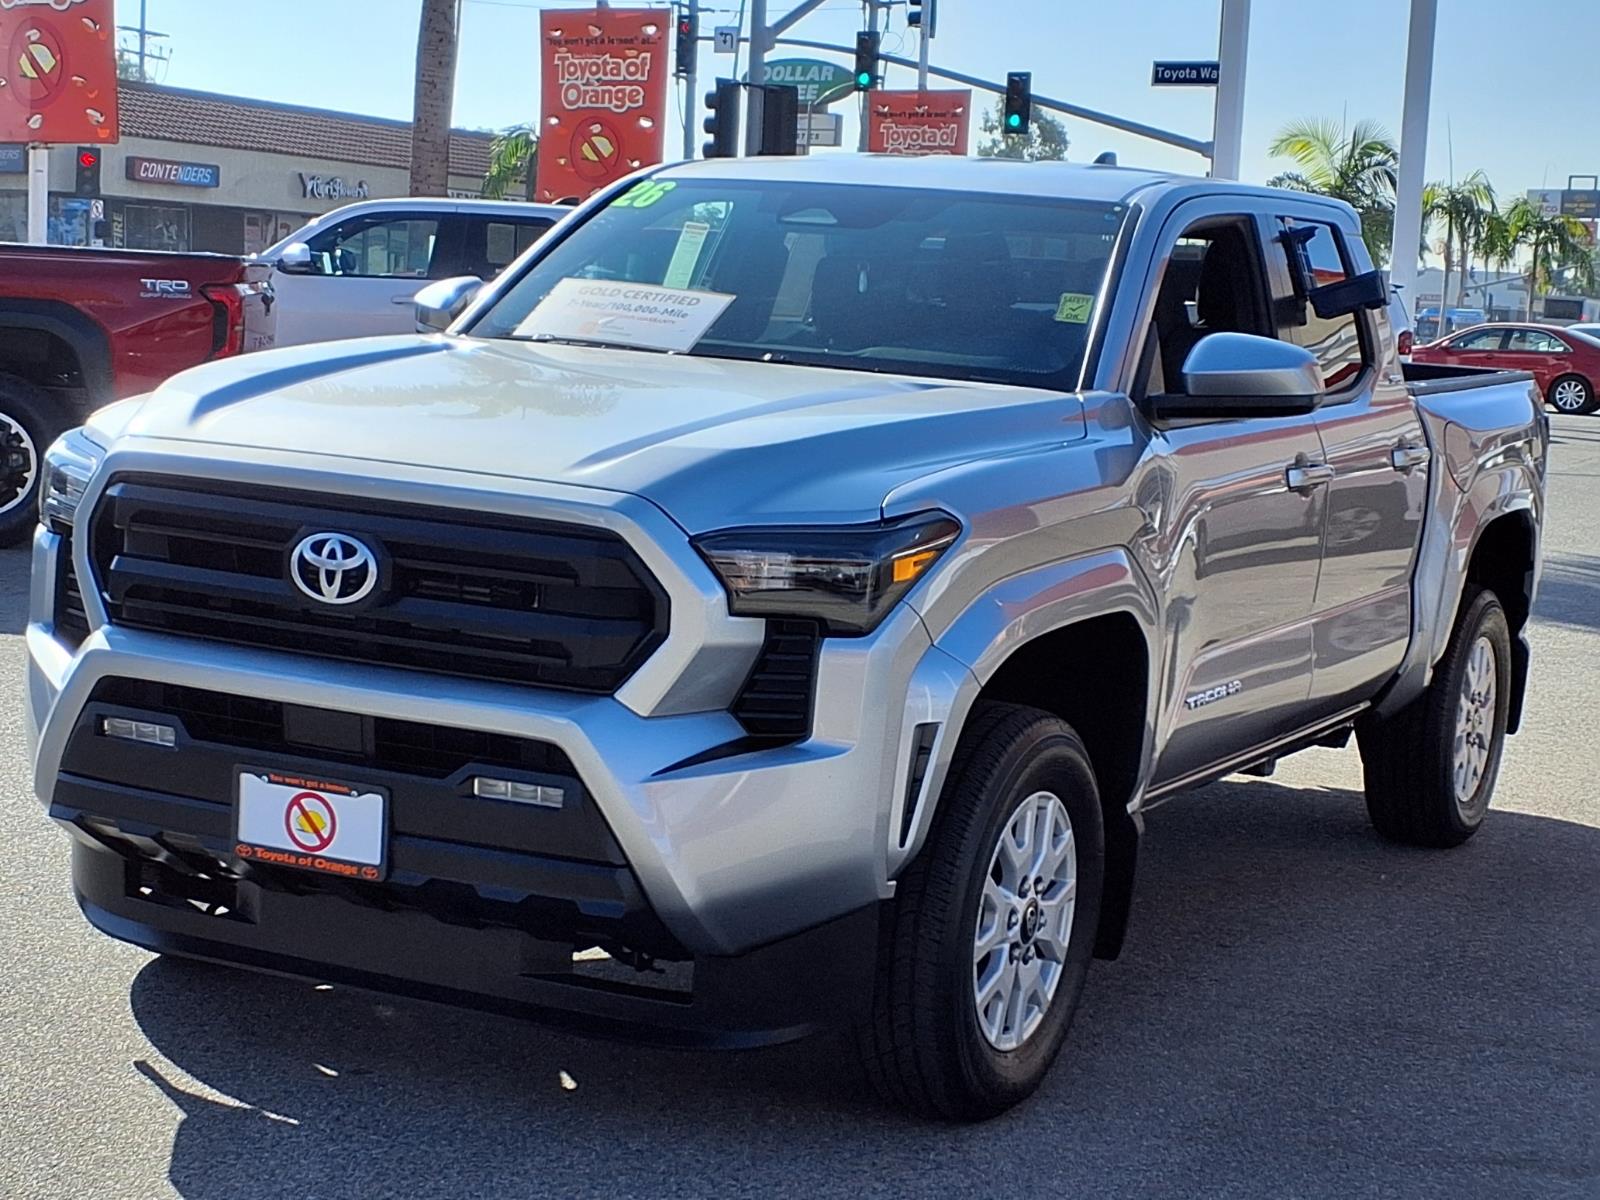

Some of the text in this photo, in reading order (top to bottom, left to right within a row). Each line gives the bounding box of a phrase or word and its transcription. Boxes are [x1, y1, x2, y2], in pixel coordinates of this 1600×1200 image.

[554, 53, 651, 83] Toyota of
[1157, 66, 1220, 81] Toyota Wa
[562, 81, 645, 112] Orange
[797, 84, 819, 100] EE
[880, 123, 957, 147] Toyota of
[140, 162, 213, 183] CONTENDERS
[611, 181, 677, 208] 26
[140, 278, 189, 292] TRD
[578, 286, 702, 307] GOLD CERTIFIED
[254, 847, 359, 876] Toyota of Orange
